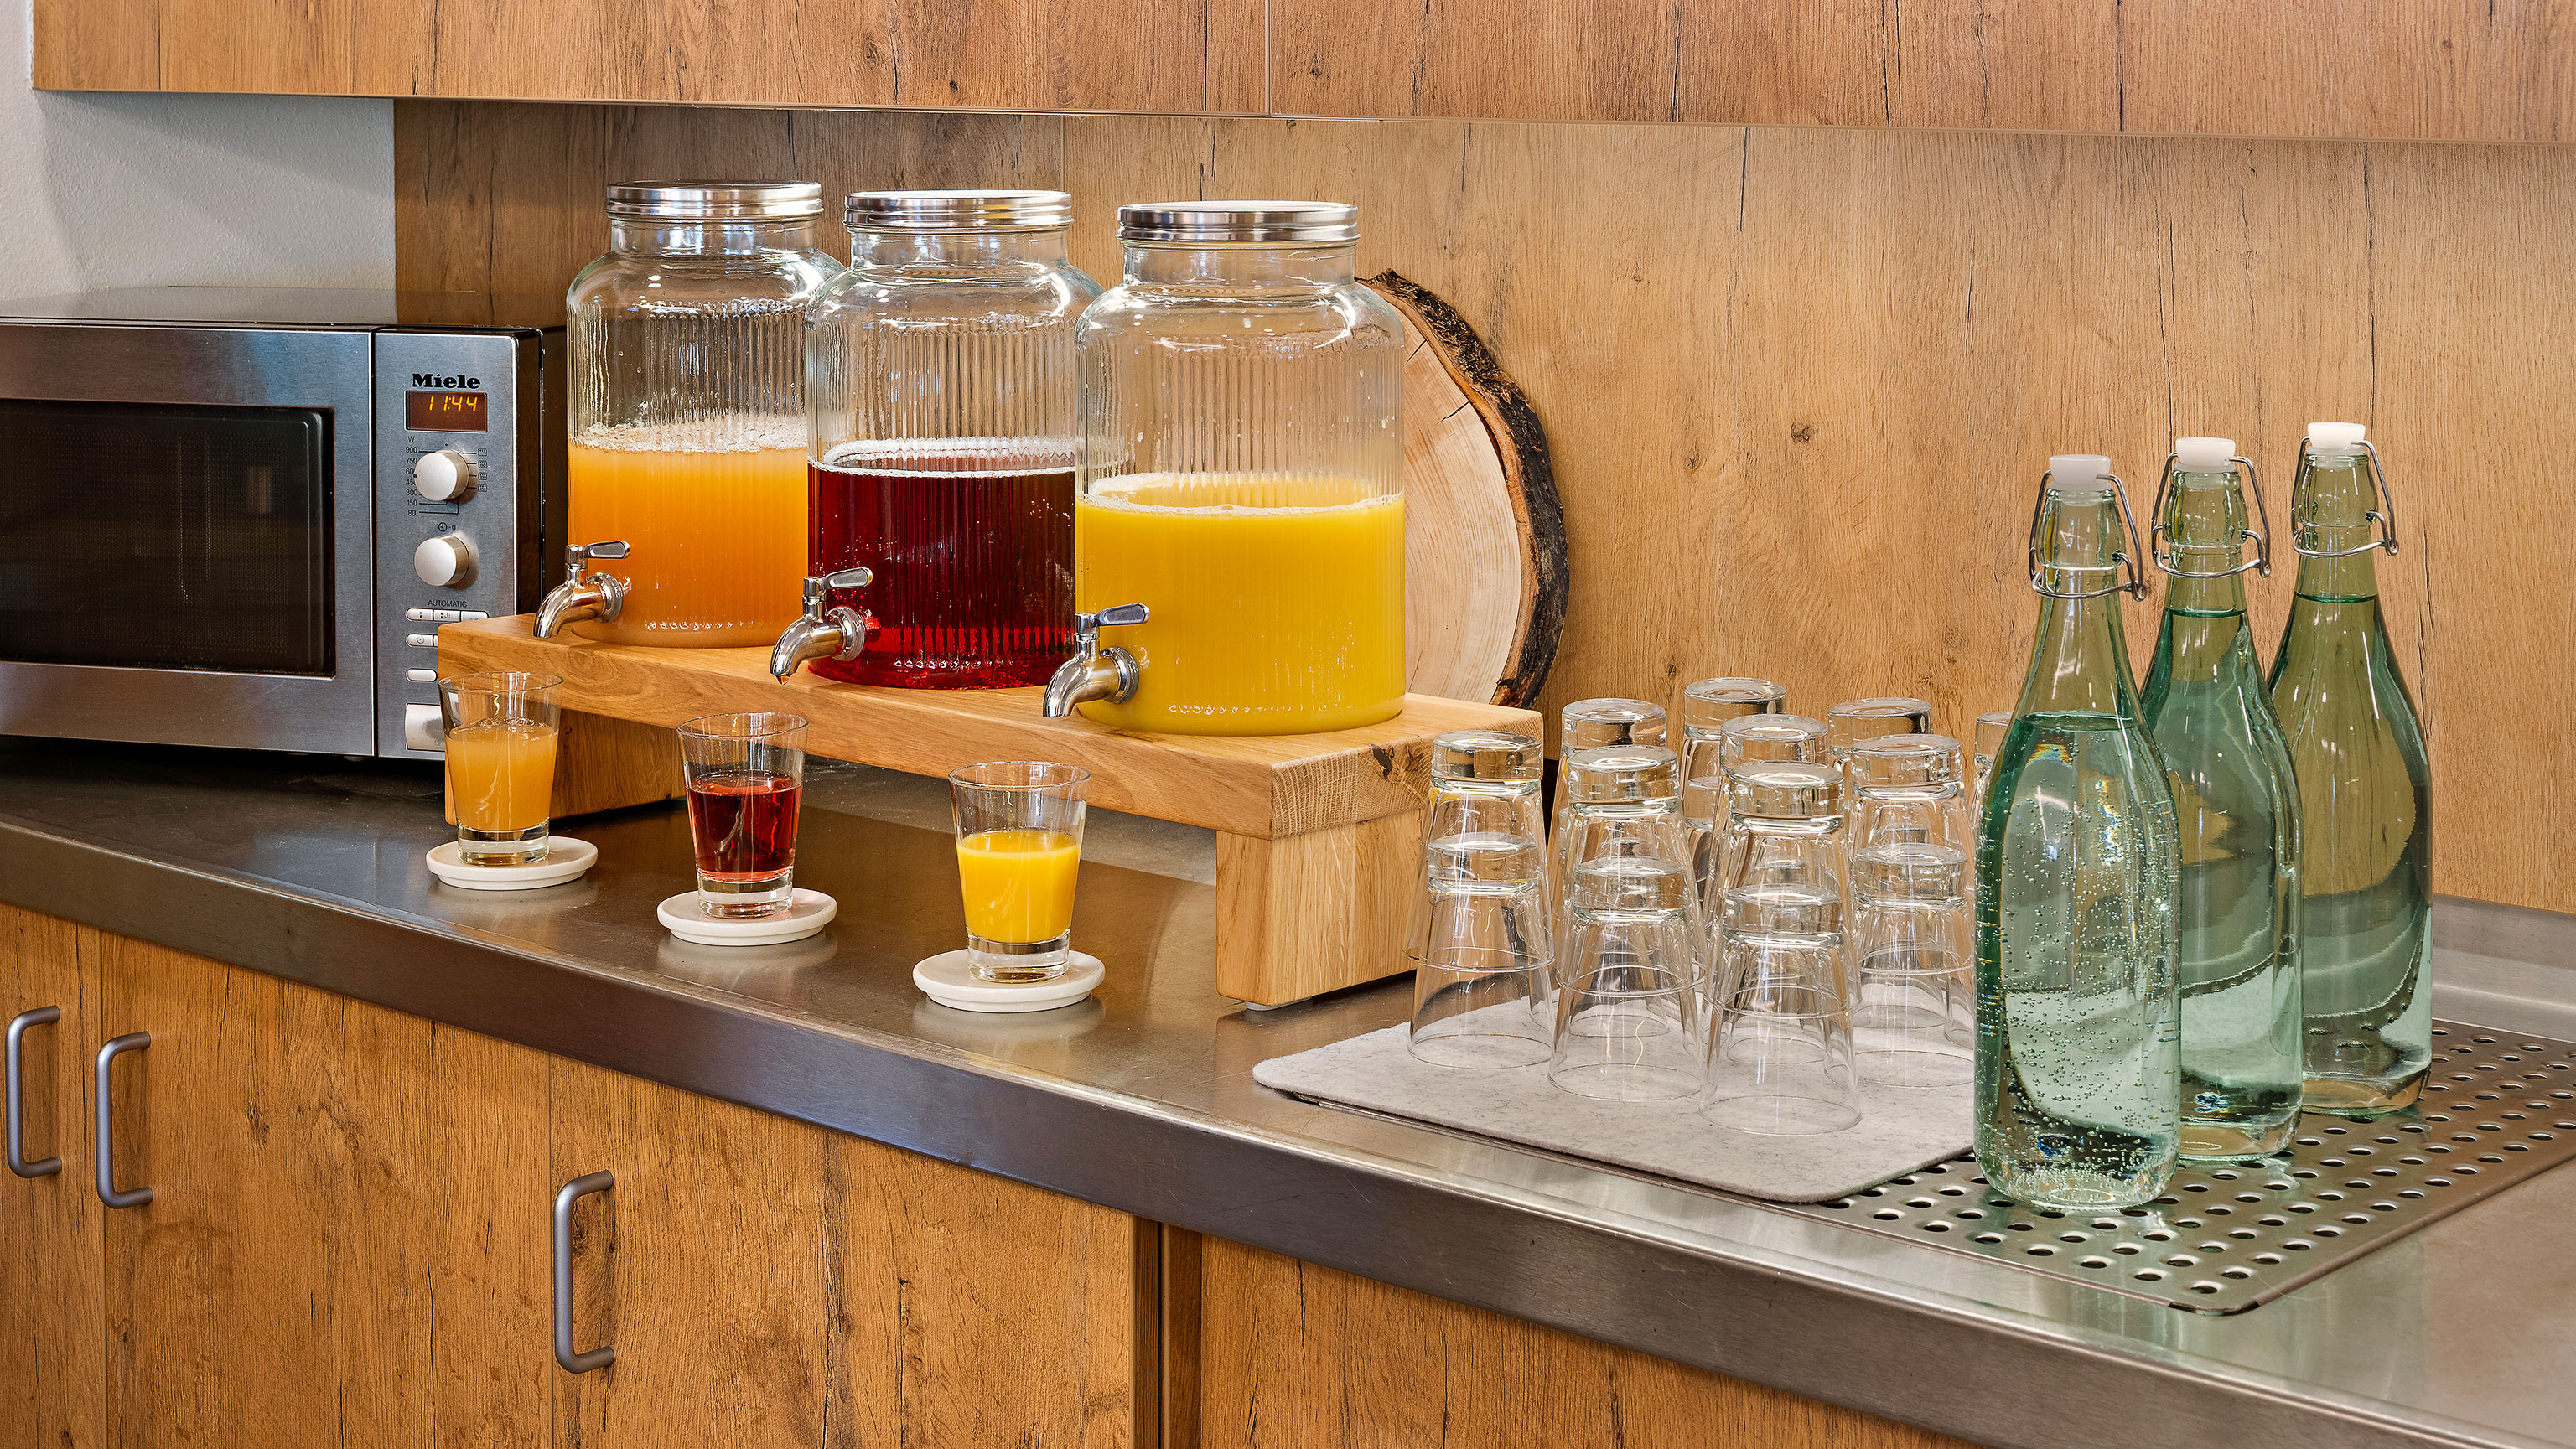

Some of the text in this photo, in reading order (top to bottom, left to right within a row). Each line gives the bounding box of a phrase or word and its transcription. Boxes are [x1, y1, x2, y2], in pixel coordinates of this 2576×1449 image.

[411, 374, 480, 389] Miele
[428, 395, 478, 412] 11:44
[428, 599, 468, 608] AUTOMATIC
